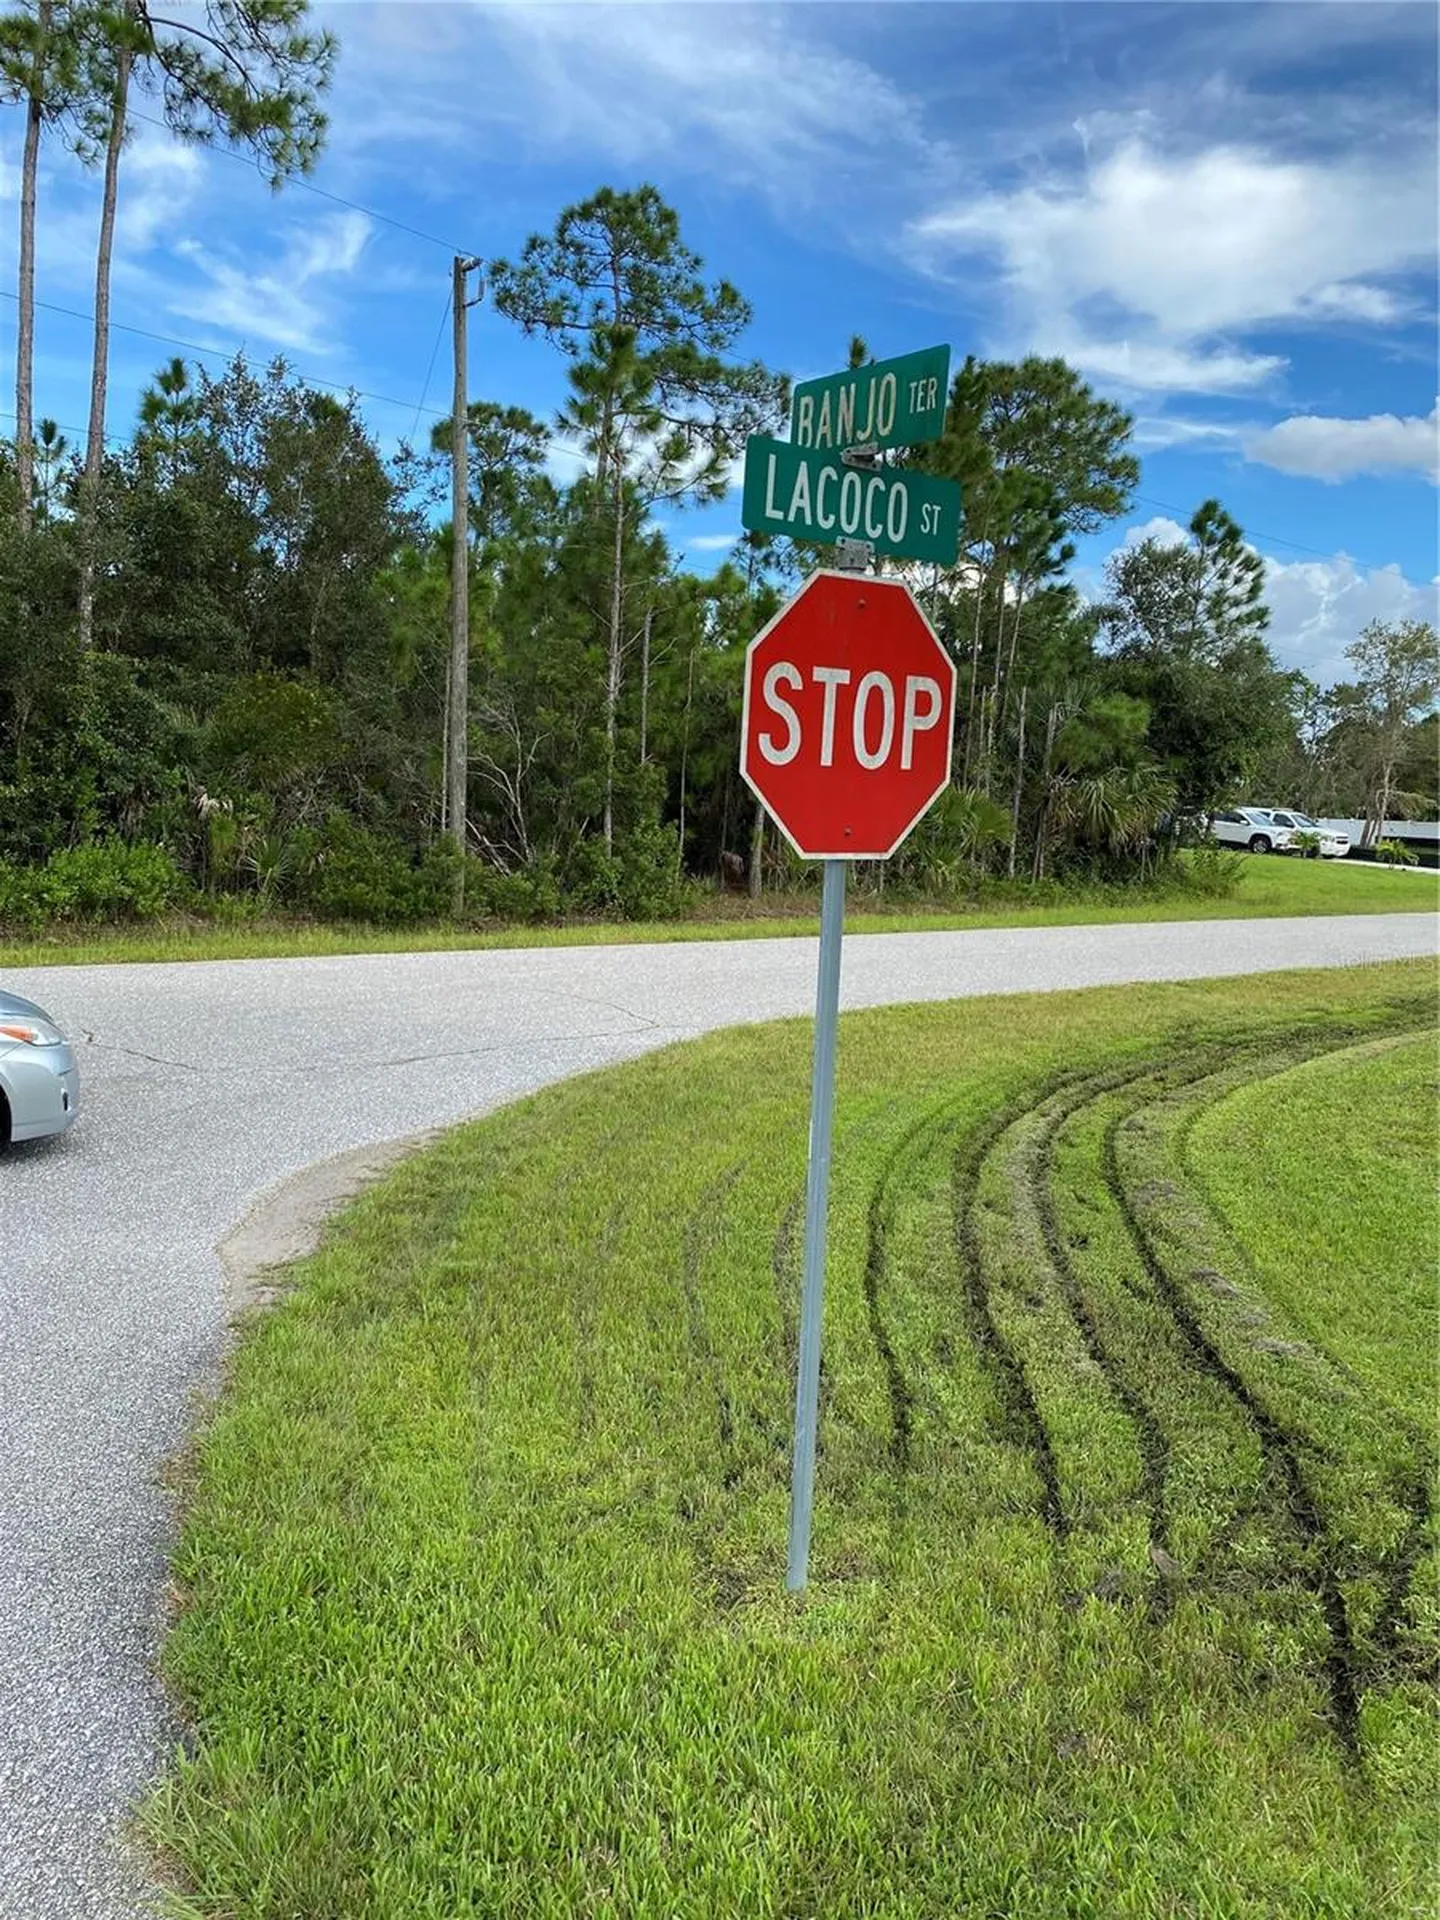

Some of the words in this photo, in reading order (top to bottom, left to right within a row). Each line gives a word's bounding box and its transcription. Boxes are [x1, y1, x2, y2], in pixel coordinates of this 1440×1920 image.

[797, 372, 897, 449] BANJO
[909, 377, 938, 414] TER
[765, 453, 908, 543] LACOCO
[920, 503, 942, 536] ST
[758, 661, 943, 770] STOP
